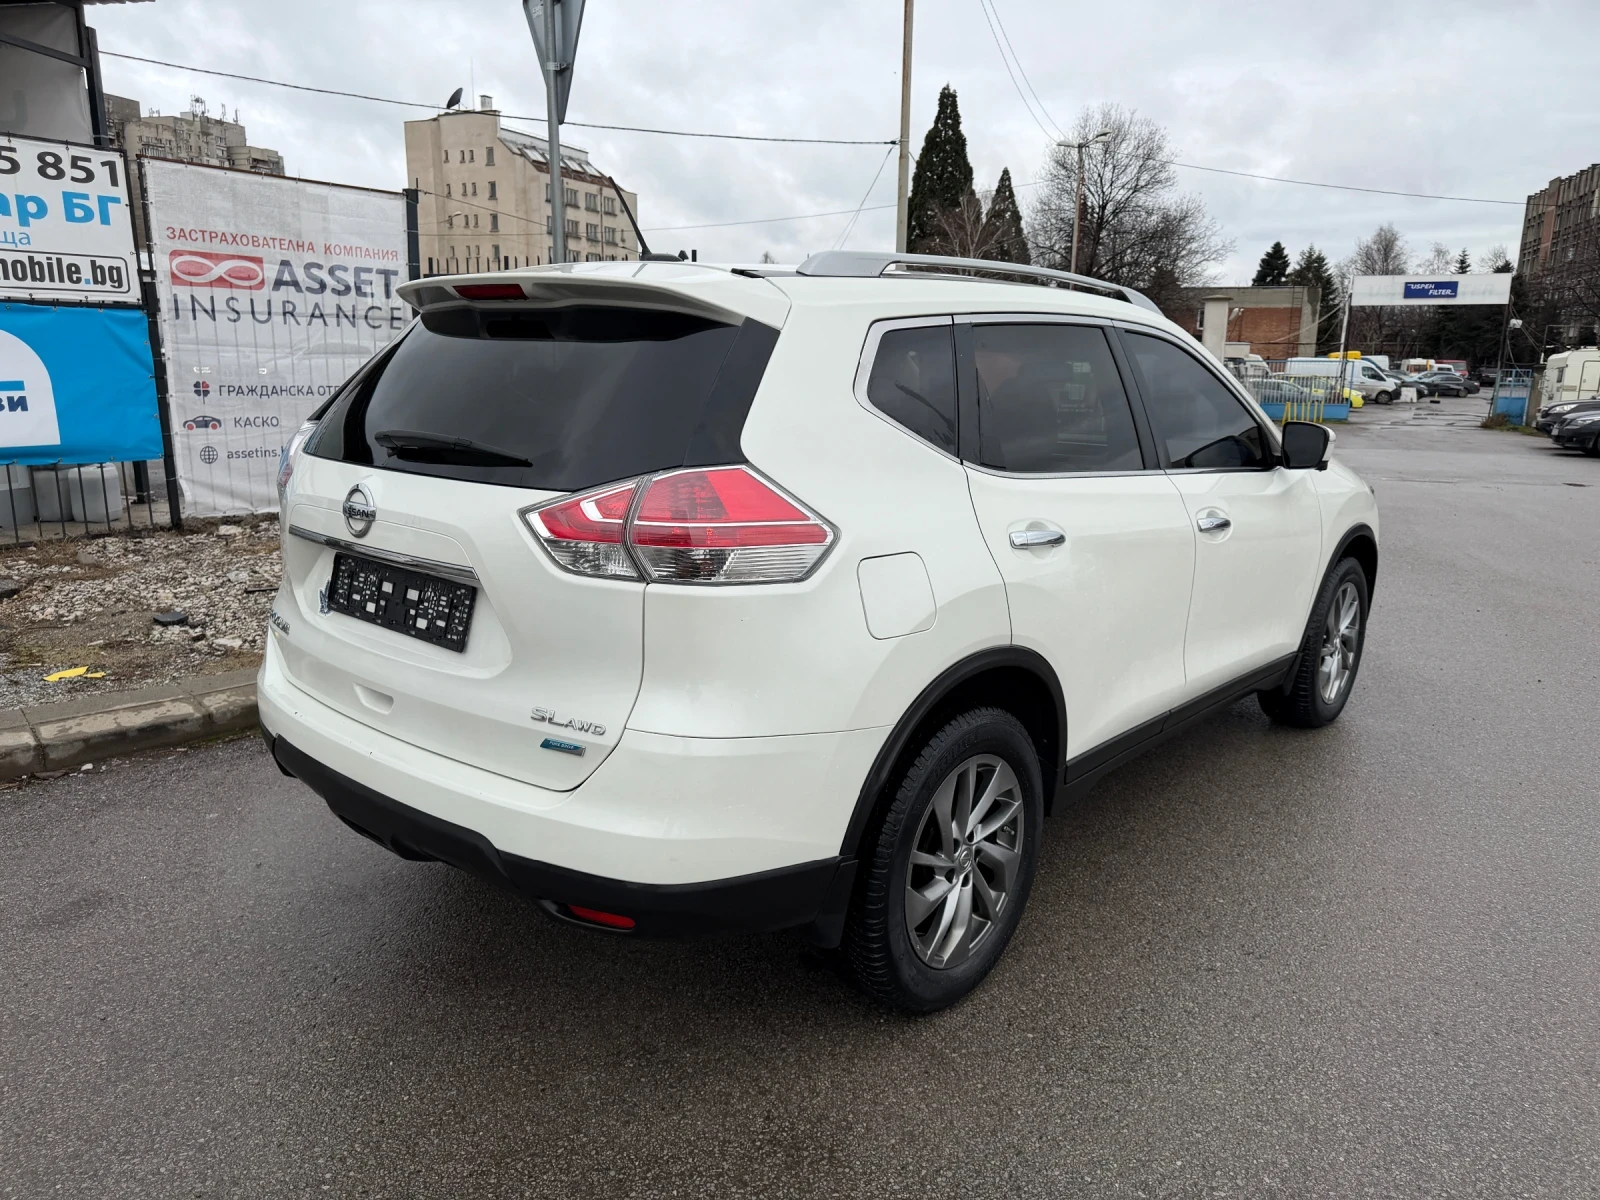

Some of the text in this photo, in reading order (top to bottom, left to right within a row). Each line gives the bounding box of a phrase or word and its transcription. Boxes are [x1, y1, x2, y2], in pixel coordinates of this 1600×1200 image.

[36, 151, 119, 188] 851
[62, 191, 122, 226] БГ
[166, 226, 399, 262] ЗАСТРАХОВАТЕЛНА КОМПАНИЯ
[271, 259, 399, 300] ASSET
[173, 292, 403, 330] INSURANCE
[218, 384, 315, 399] ГРАЖДАНСКА
[234, 416, 280, 428] КАСКО
[530, 706, 607, 736] SL AWD
